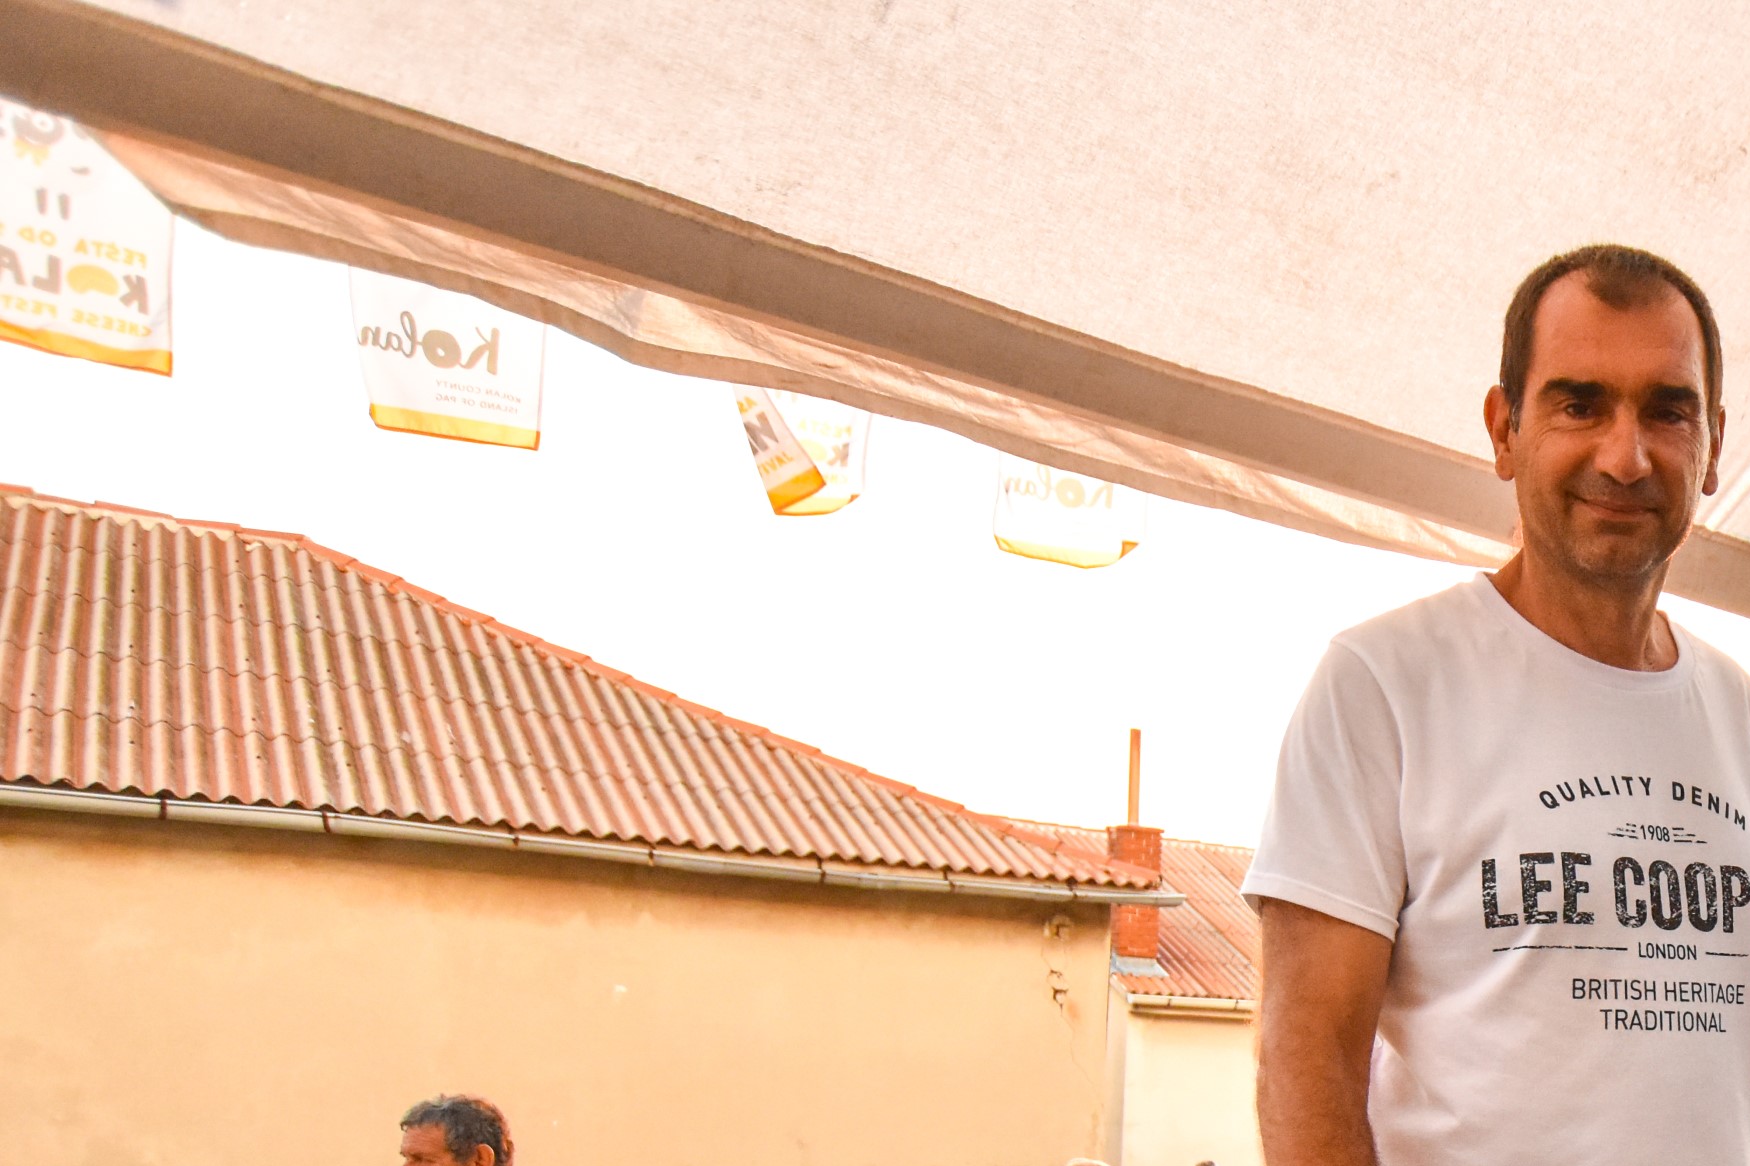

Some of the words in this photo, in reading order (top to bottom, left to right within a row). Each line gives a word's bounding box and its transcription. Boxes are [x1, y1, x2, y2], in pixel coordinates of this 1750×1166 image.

[1538, 775, 1652, 809] QUALITY
[1671, 780, 1747, 831] DENIM
[1639, 824, 1671, 843] 1908
[1481, 851, 1595, 929] LEE
[1637, 942, 1698, 961] LONDON
[1571, 977, 1657, 1001] BRITISH
[1663, 980, 1746, 1005] HERITAGE
[1599, 1008, 1727, 1034] TRADITIONAL
